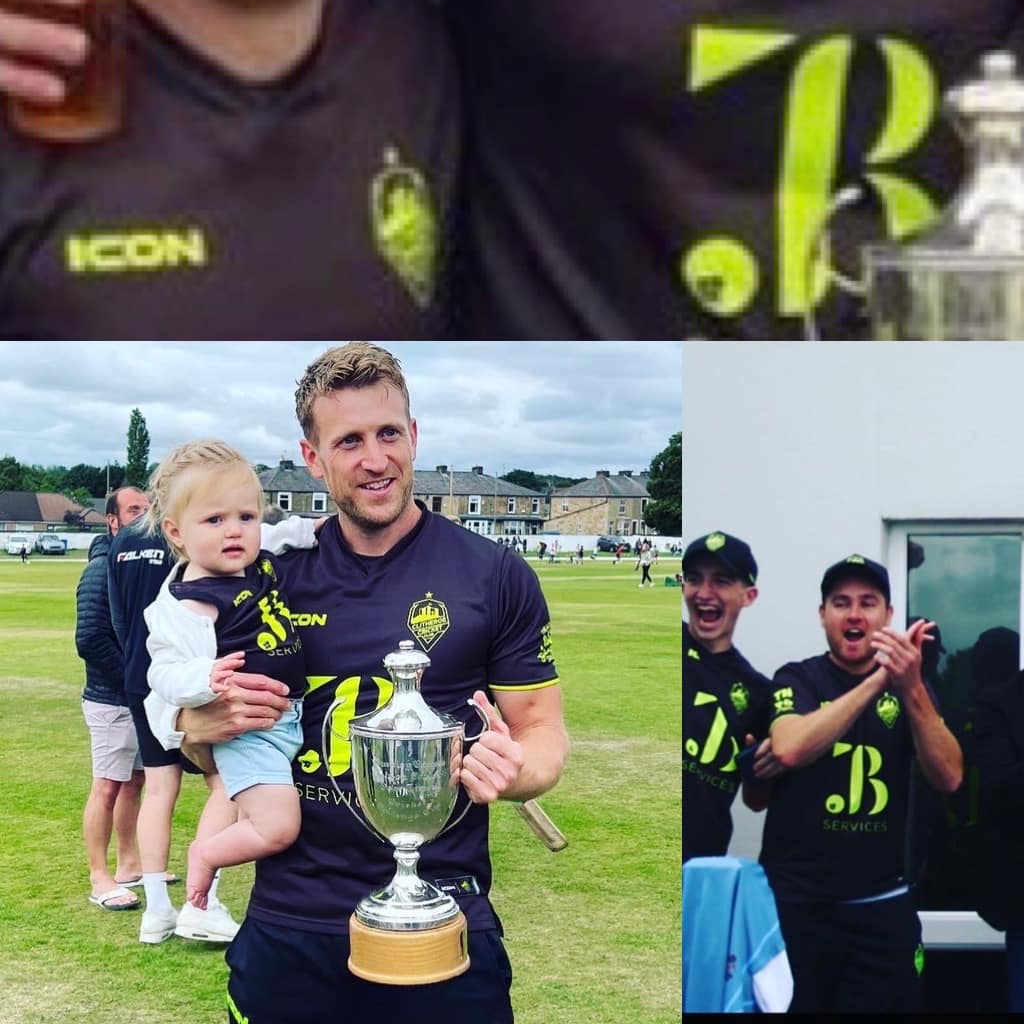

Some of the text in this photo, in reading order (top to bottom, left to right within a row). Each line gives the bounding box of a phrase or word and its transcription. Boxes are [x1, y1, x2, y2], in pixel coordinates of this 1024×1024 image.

[65, 229, 206, 272] ICON
[117, 549, 165, 563] FALKEN
[289, 614, 328, 627] CON
[823, 819, 888, 833] SERVICES
